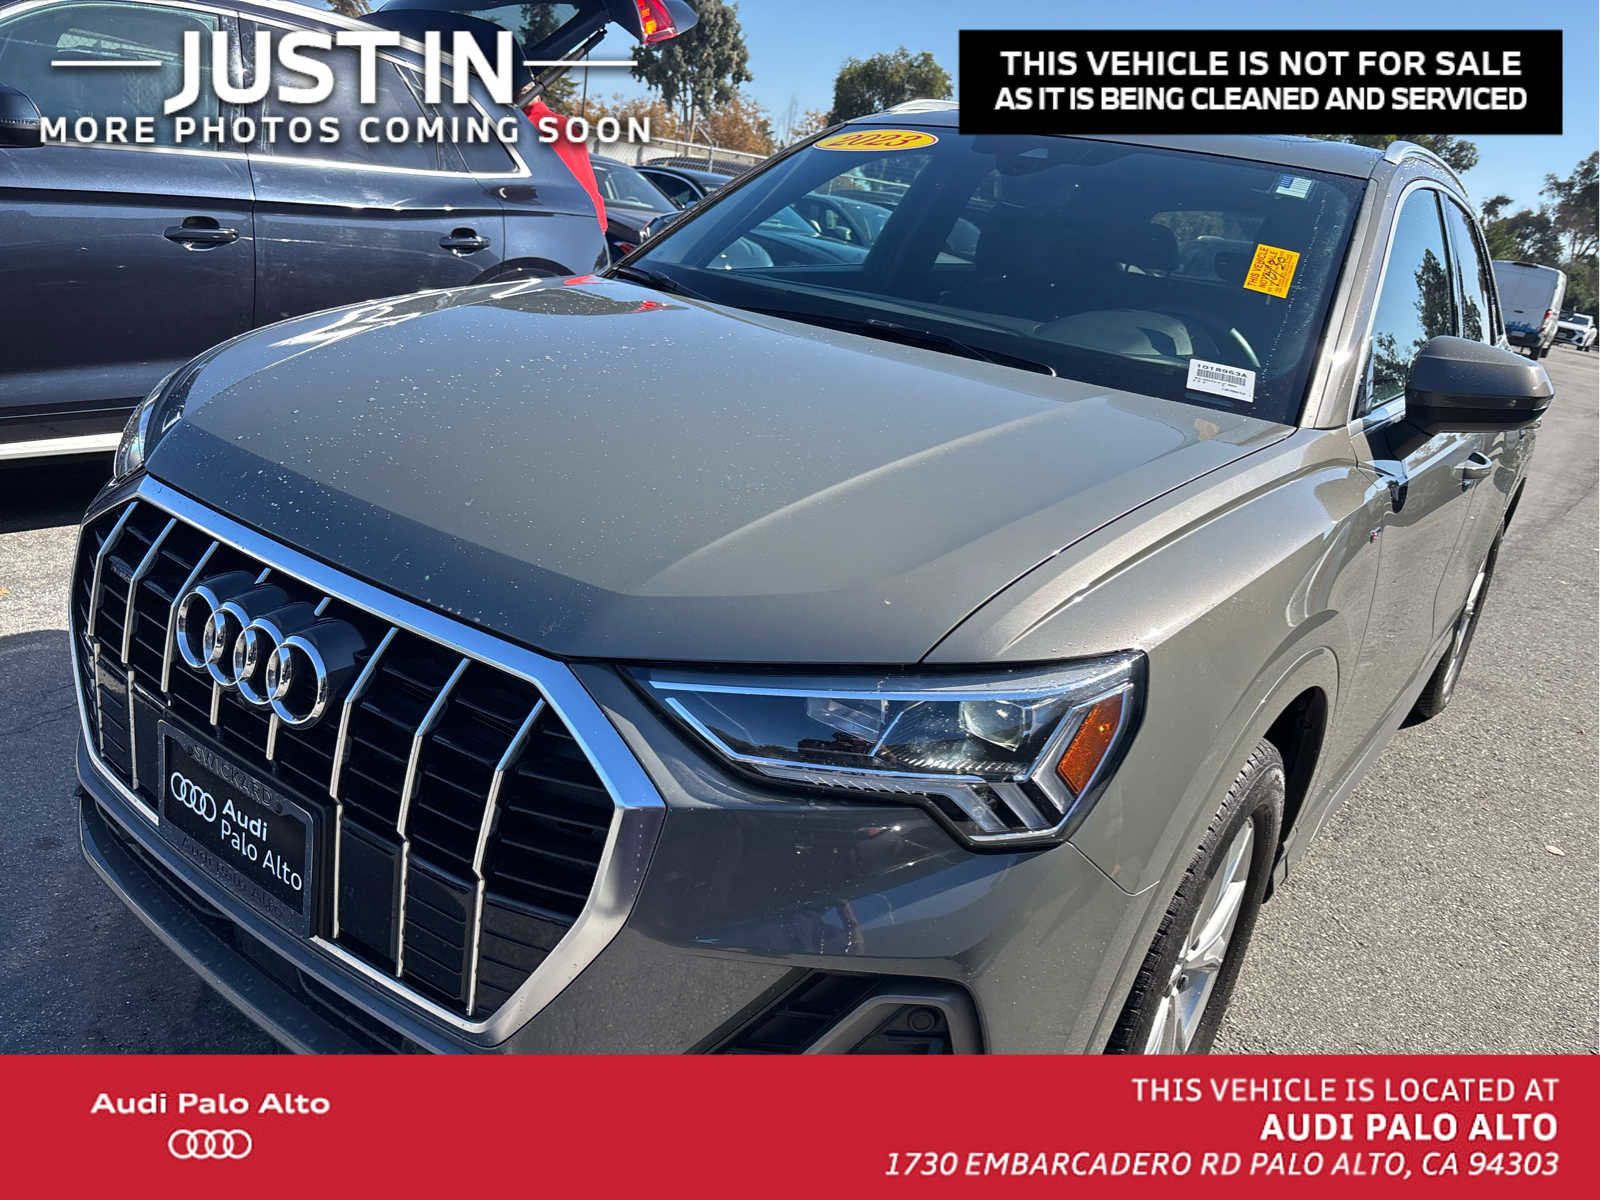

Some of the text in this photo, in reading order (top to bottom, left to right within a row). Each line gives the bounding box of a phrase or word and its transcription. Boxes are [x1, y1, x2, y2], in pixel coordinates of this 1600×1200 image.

[827, 134, 923, 146] 2023
[191, 744, 273, 807] SWICKARD
[222, 799, 268, 842] Audi
[221, 818, 303, 891] Palo Alto
